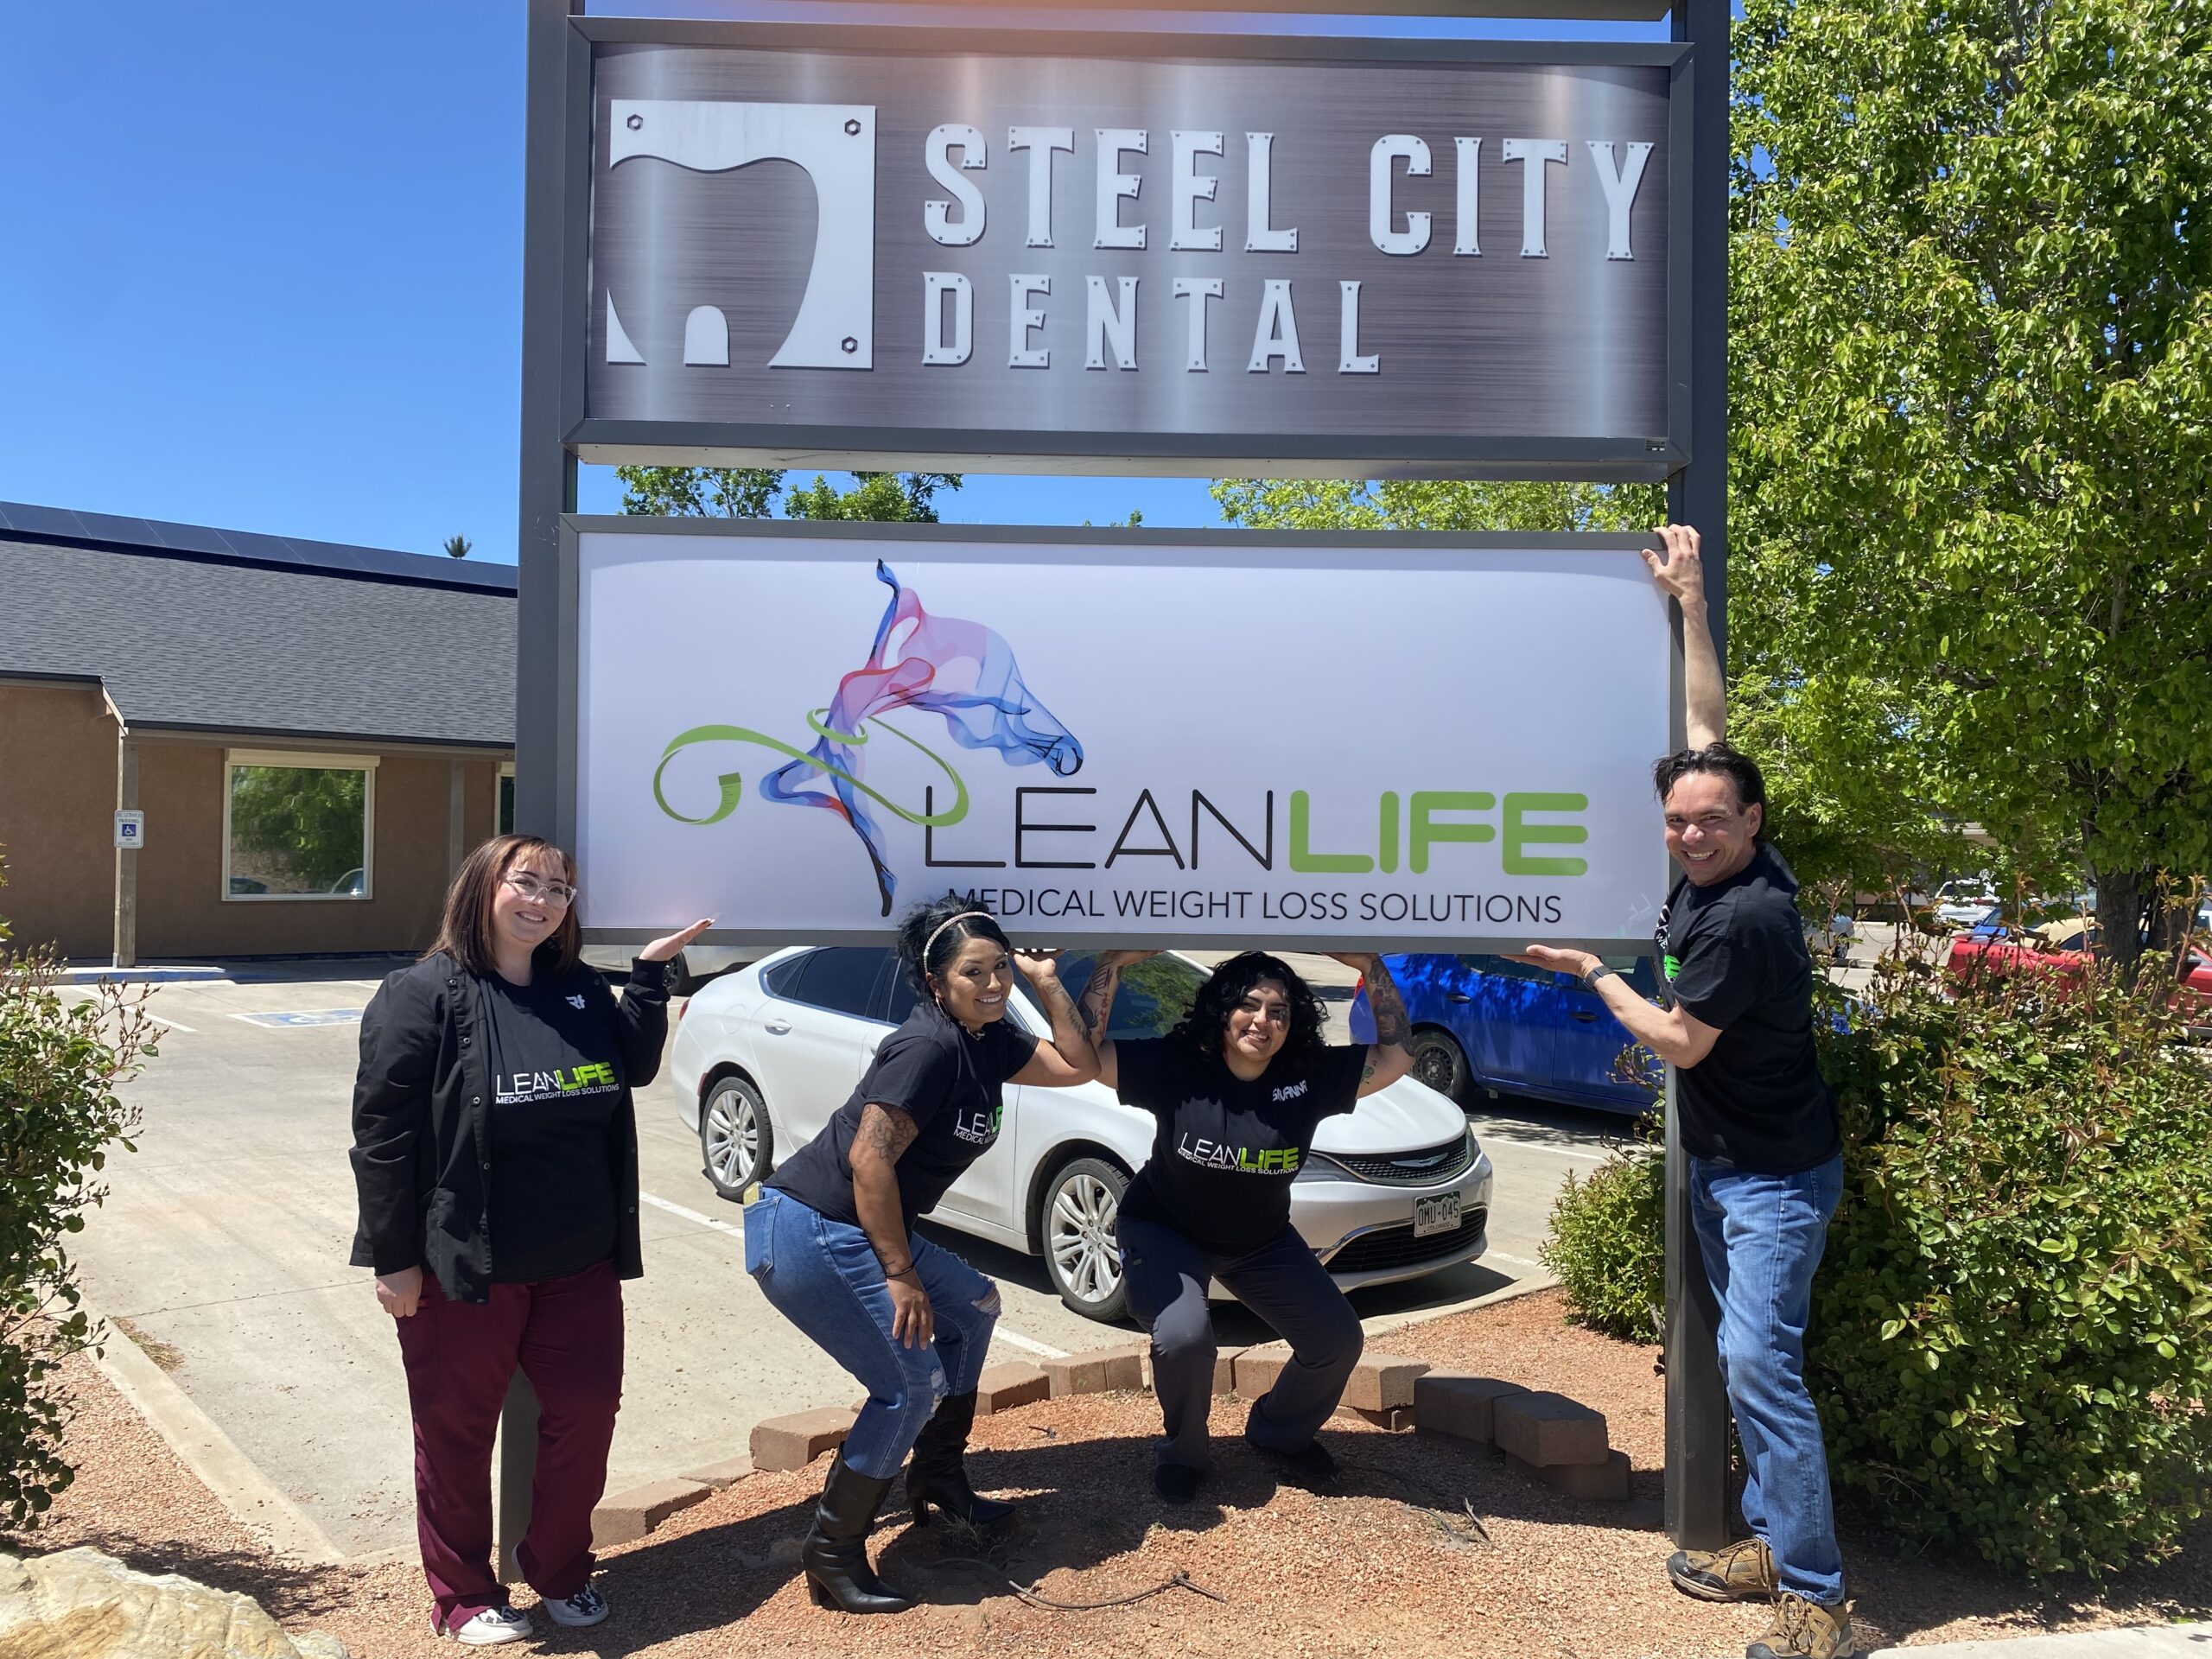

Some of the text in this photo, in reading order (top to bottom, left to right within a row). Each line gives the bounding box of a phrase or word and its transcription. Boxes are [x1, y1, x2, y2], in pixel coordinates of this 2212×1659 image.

[924, 123, 1654, 260] STEEL CITY
[922, 272, 1380, 372] DENTAL
[1113, 890, 1253, 918] WEIGHT
[1263, 892, 1348, 920] LOSS
[1360, 893, 1562, 923] SOLUTIONS
[495, 1084, 620, 1104] MEDICAL WEIGHT LOSS SOLUTIONS
[953, 1128, 984, 1145] MEDICAL
[1177, 1147, 1300, 1176] MEDICAL WEIGHT LOSS SOLUTIONS
